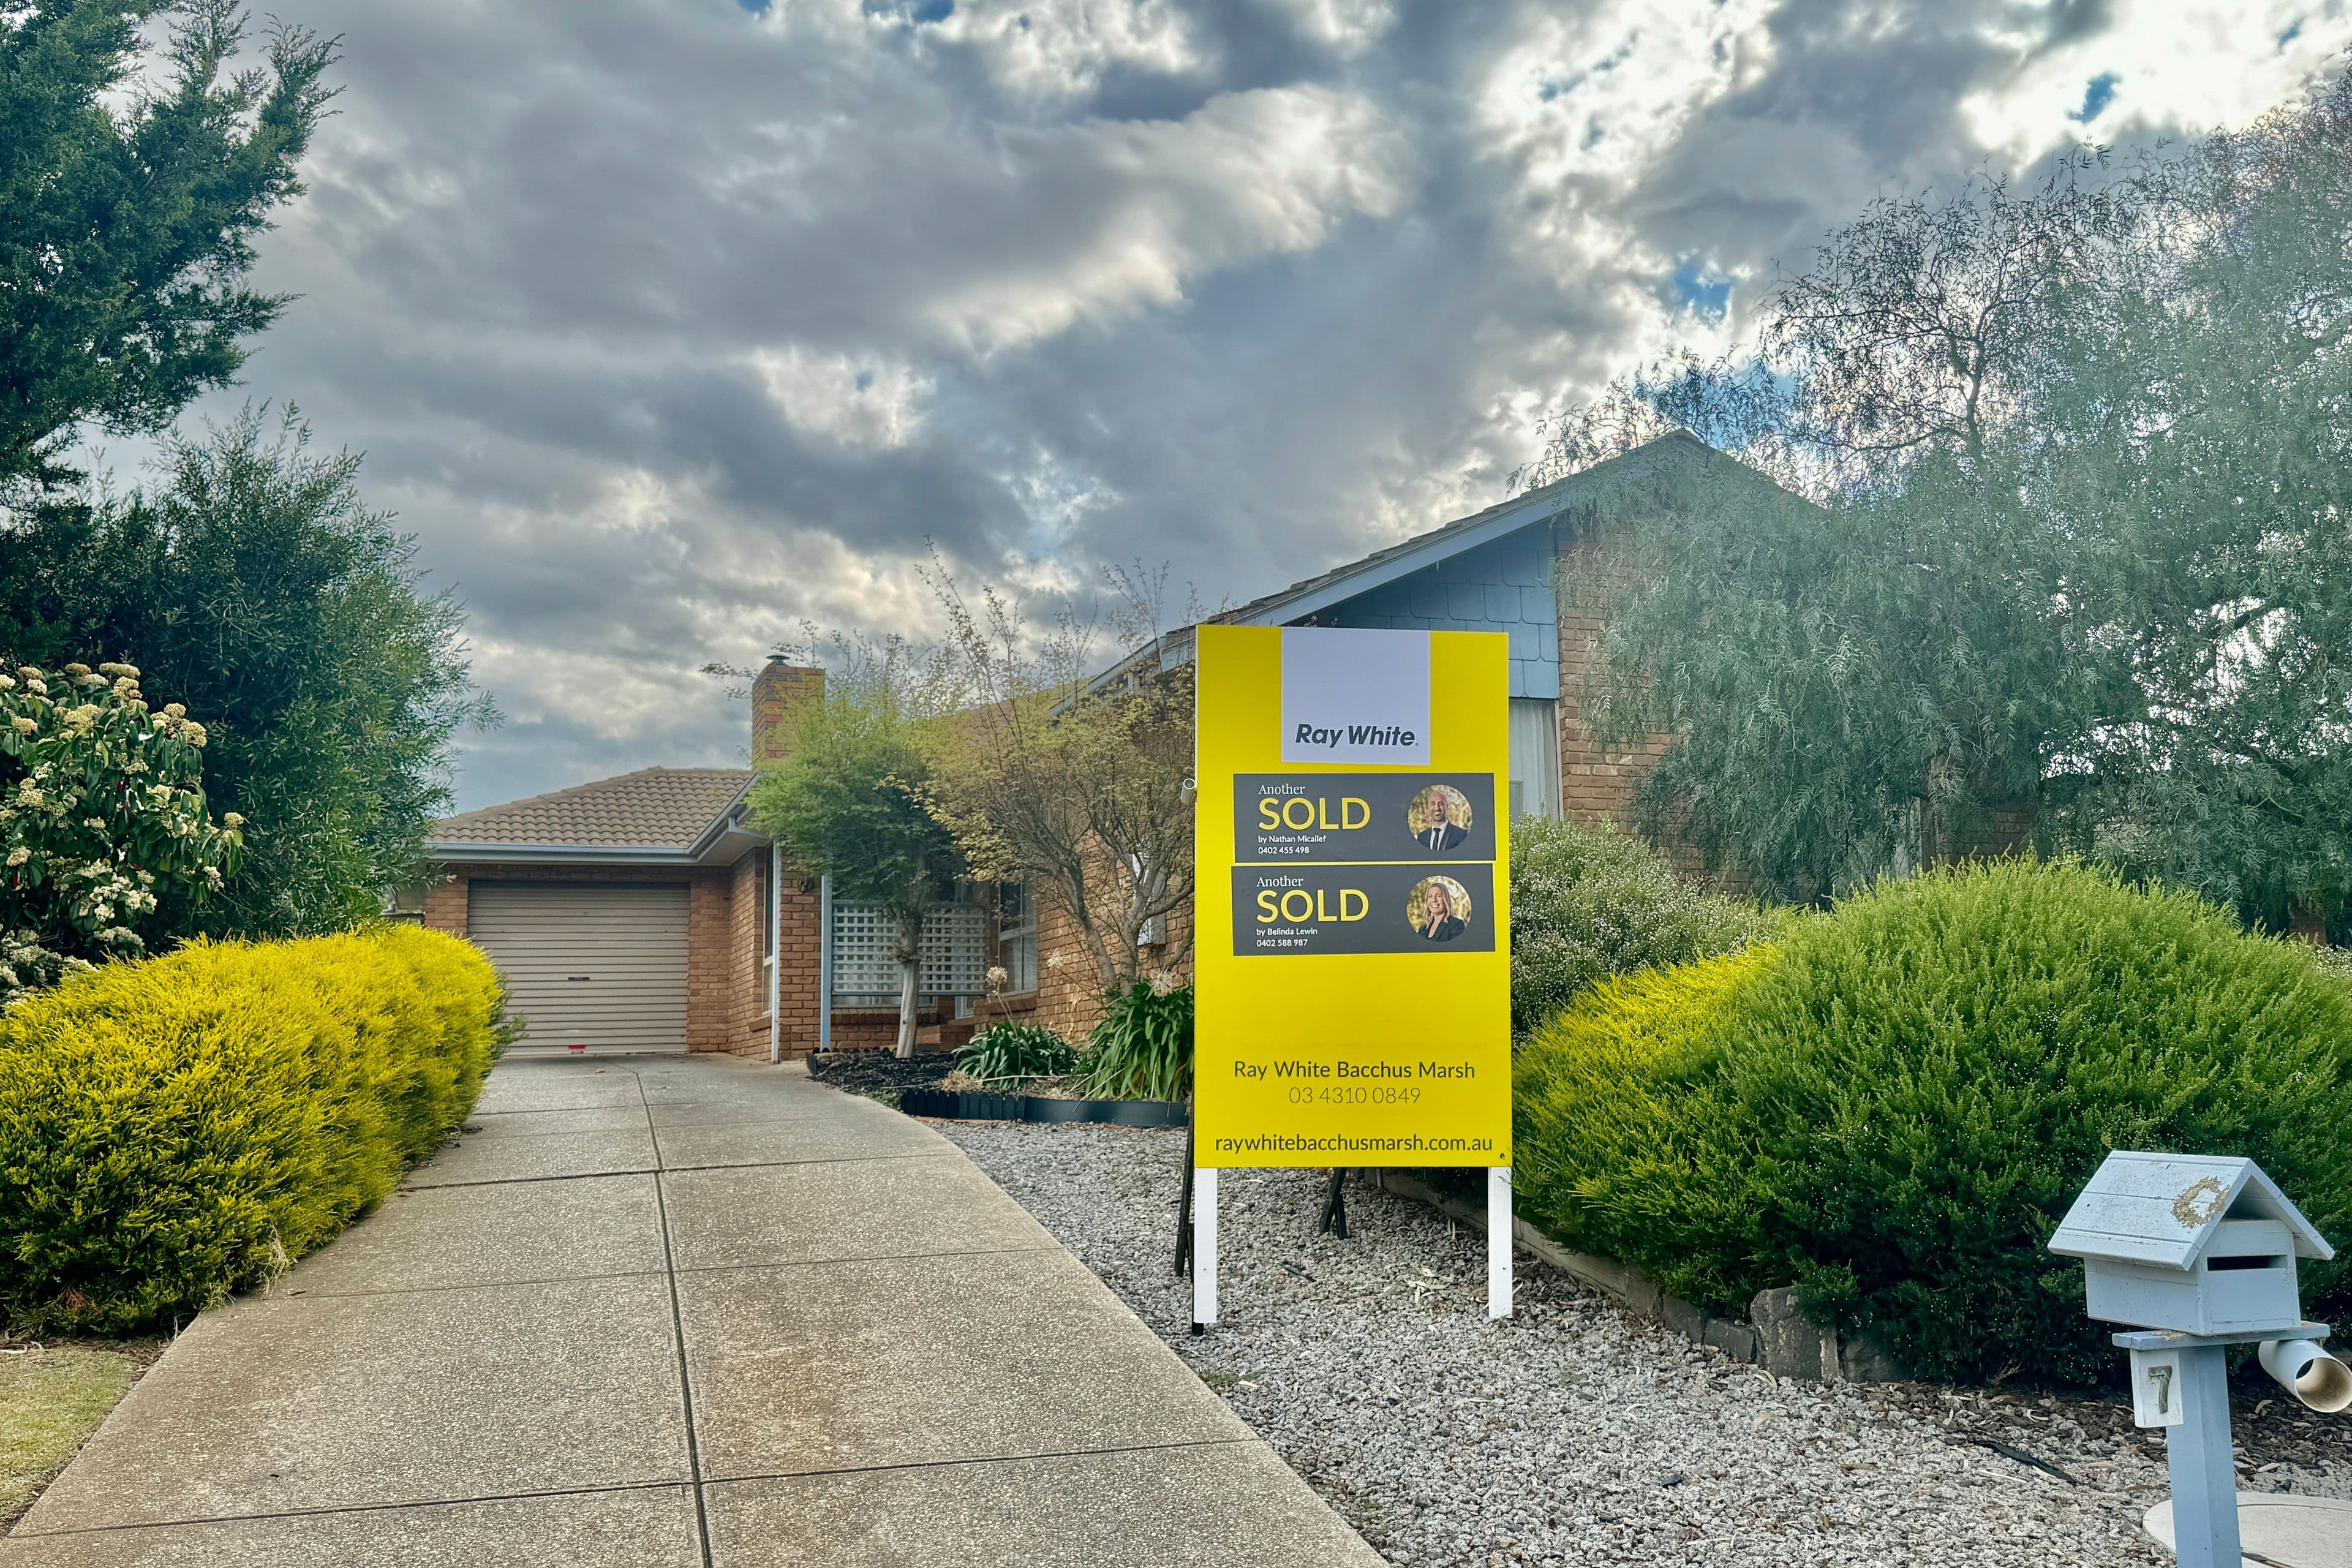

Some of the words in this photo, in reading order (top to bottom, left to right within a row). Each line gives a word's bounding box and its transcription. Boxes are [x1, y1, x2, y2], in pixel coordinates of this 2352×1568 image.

[1295, 723, 1344, 748] Ray
[1258, 783, 1305, 795] Another
[1258, 797, 1371, 831] SOLD
[1257, 835, 1267, 844] by
[1268, 835, 1296, 843] Nathan
[1256, 875, 1304, 887] Another
[1256, 889, 1369, 923] SOLD
[1256, 928, 1266, 937] by
[1267, 927, 1294, 936] Belinda
[1234, 1061, 1268, 1081] Ray
[1273, 1060, 1330, 1078] White
[1337, 1061, 1412, 1078] Bacchus
[1419, 1061, 1475, 1078] Marsh
[1289, 1087, 1313, 1104] 03
[1319, 1087, 1367, 1104] 4310
[1372, 1087, 1421, 1104] 0849
[1215, 1133, 1492, 1155] raywhitebacchusmarsh.com.au
[2148, 1365, 2173, 1415] 7
